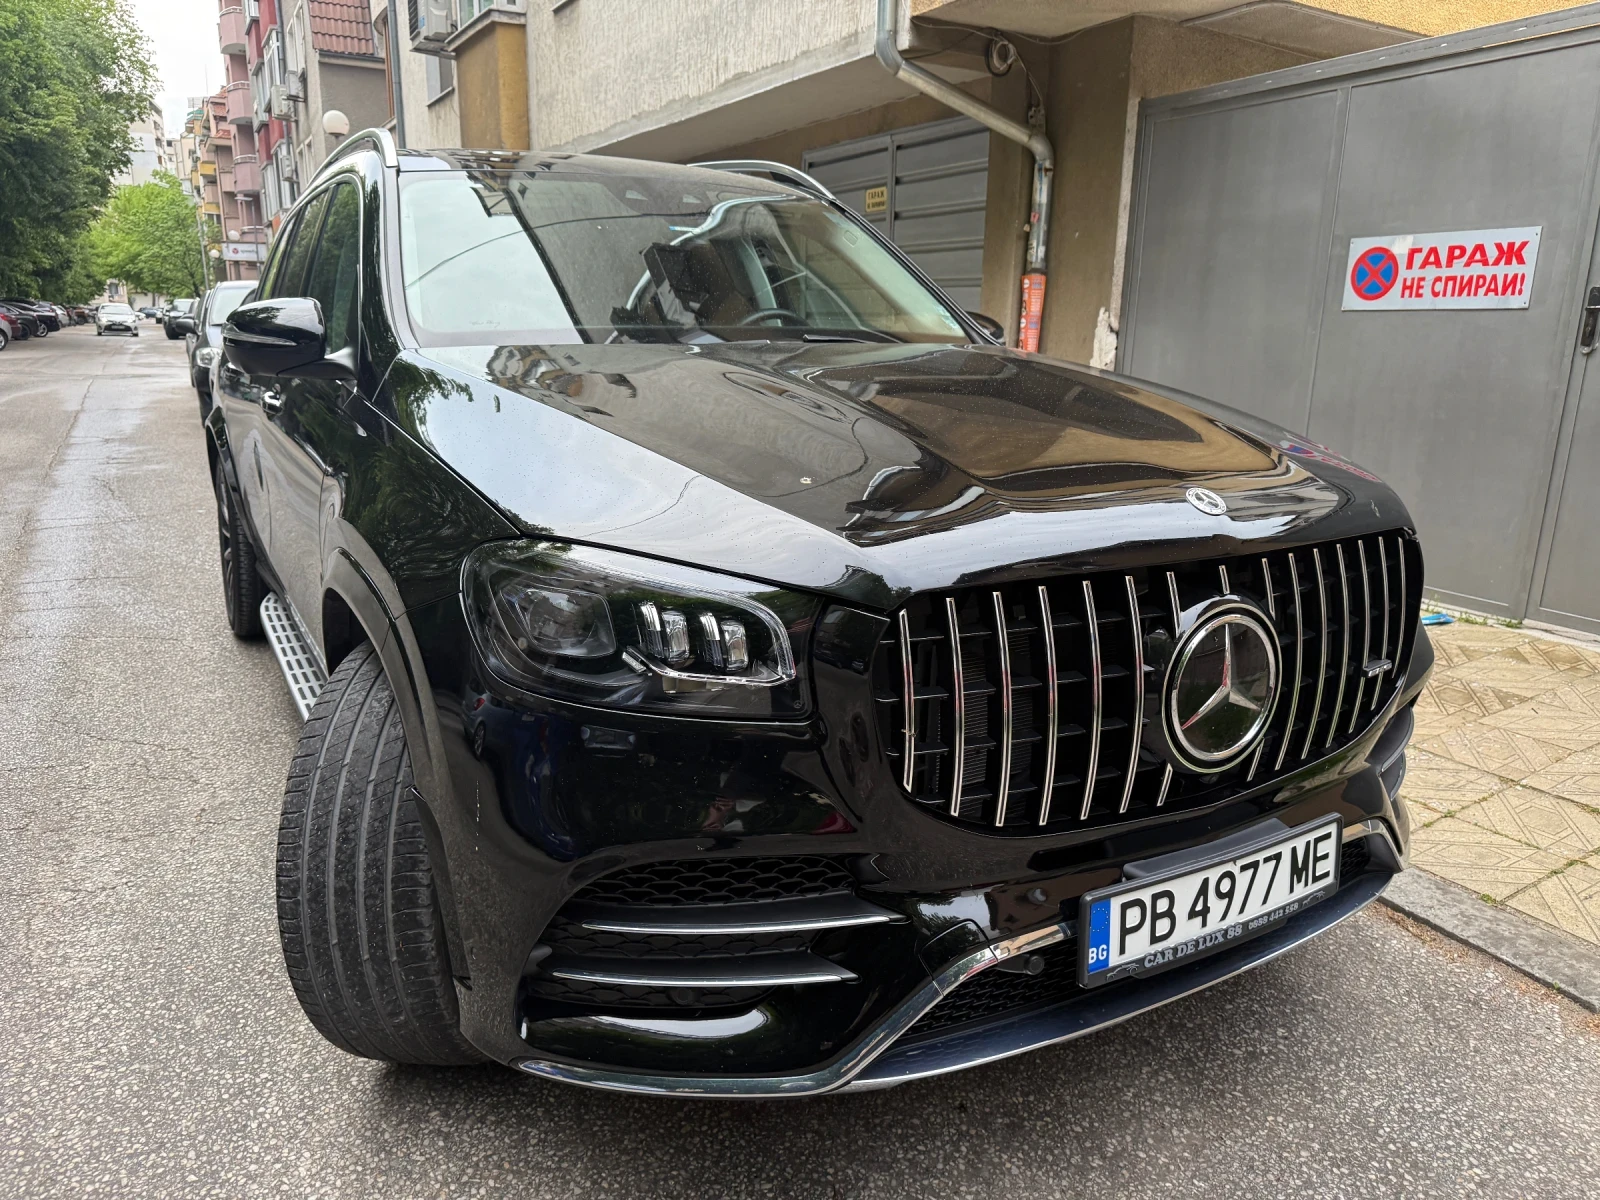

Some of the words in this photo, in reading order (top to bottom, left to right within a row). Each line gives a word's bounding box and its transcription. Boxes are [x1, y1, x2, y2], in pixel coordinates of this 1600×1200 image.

[1405, 240, 1530, 270] ГАРАЖ
[1400, 276, 1426, 299] НЕ
[1118, 888, 1177, 956] PB
[1187, 850, 1283, 929] 4977
[1288, 831, 1333, 895] ME
[1088, 944, 1108, 964] BG
[1144, 948, 1174, 968] CAR
[1176, 940, 1196, 958] DE
[1197, 930, 1225, 950] LUX
[1226, 924, 1243, 939] 88
